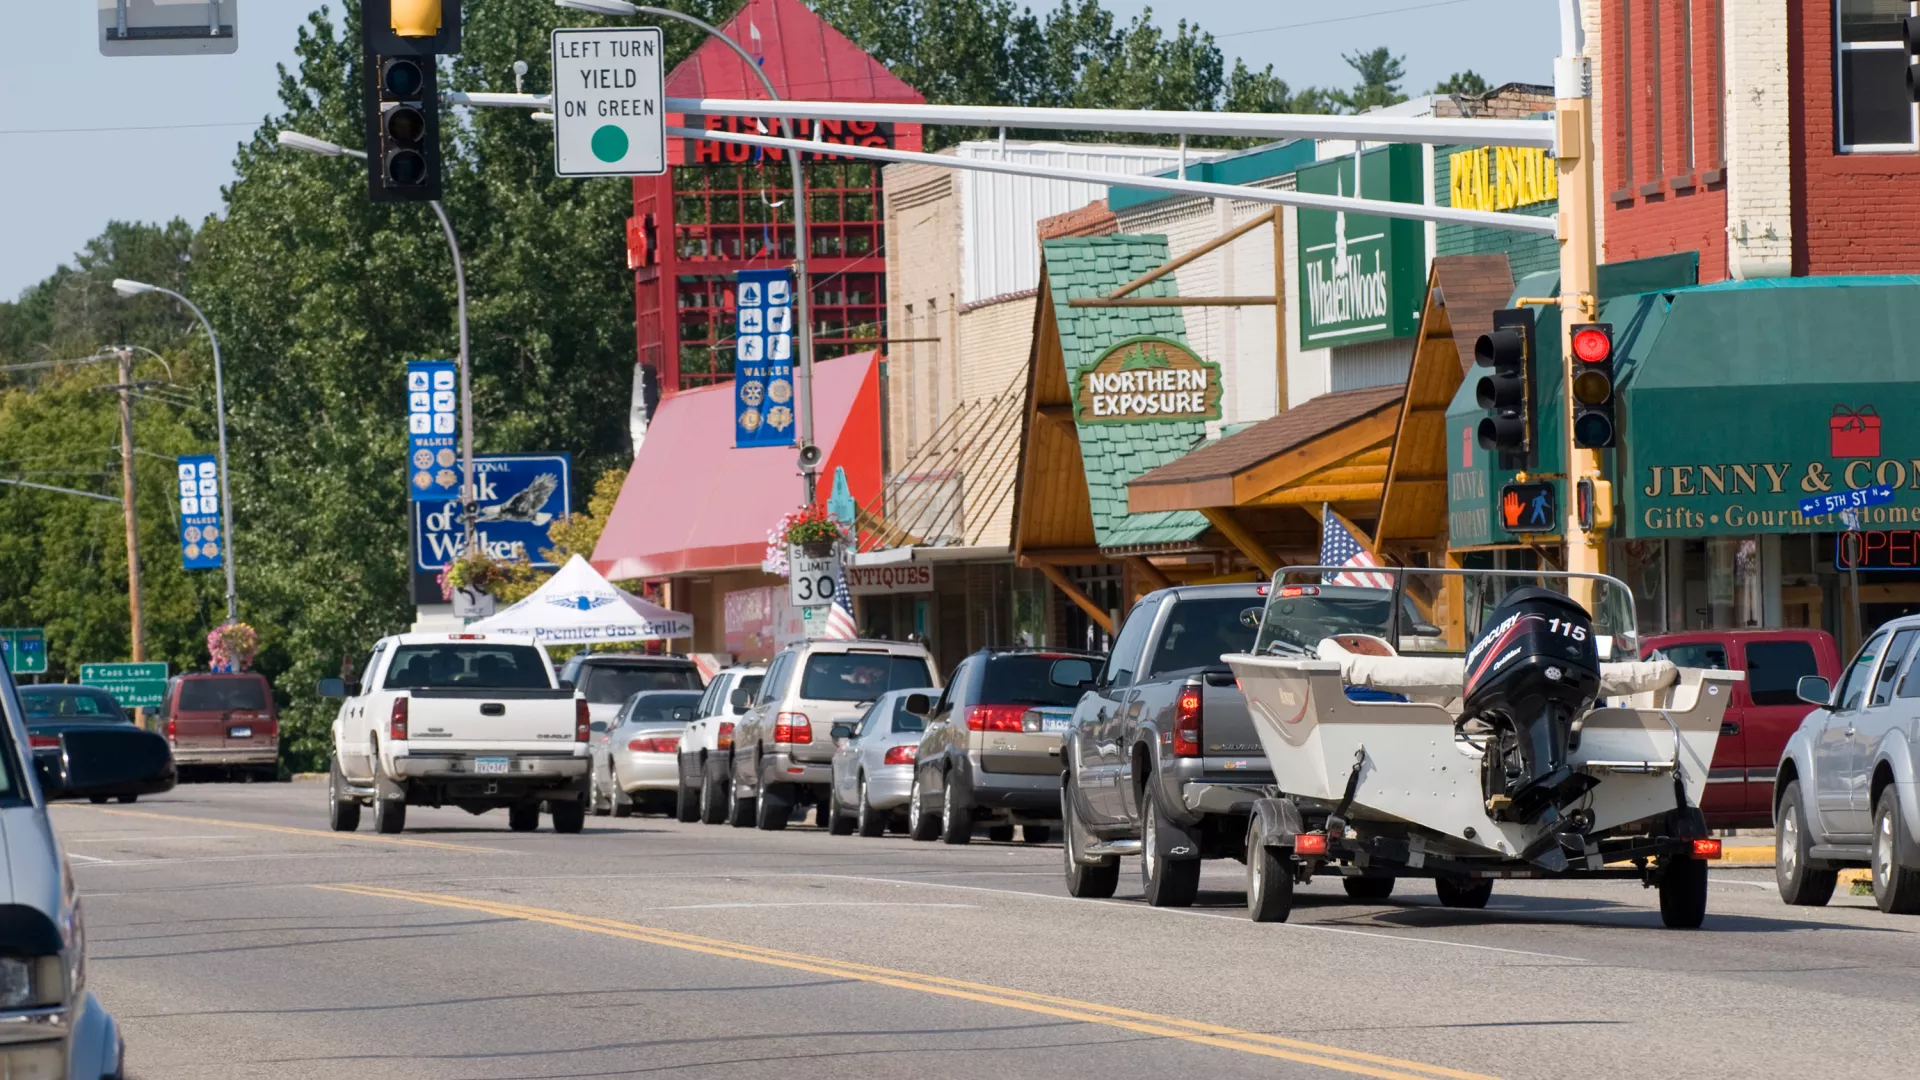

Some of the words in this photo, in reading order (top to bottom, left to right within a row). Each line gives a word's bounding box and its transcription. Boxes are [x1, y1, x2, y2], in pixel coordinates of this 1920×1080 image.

[561, 41, 601, 58] LEFT
[610, 40, 654, 57] TURN
[580, 68, 637, 89] YIELD
[564, 100, 587, 117] ON
[598, 99, 654, 116] GREEN
[1449, 146, 1494, 212] REAL
[1496, 146, 1558, 210] ESTATE
[743, 366, 790, 377] WALKER
[1089, 369, 1207, 393] NORTHERN
[1093, 391, 1205, 415] EXPOSURE
[415, 437, 453, 447] WALKER
[456, 462, 510, 473] NTIONAL
[1645, 463, 1790, 496] JENNY
[1800, 461, 1832, 492] &
[1815, 499, 1820, 507] S
[1825, 494, 1846, 511] 5TH
[1852, 490, 1867, 506] ST
[1872, 488, 1878, 496] N
[426, 502, 457, 532] of
[1644, 507, 1704, 529] Gifts
[799, 561, 831, 573] LIMIT
[848, 565, 930, 589] NTIQUES
[798, 575, 836, 601] 30
[535, 627, 600, 641] Premier
[605, 623, 637, 637] Gas
[642, 620, 677, 636] Grill
[1549, 618, 1587, 641] 115
[99, 668, 123, 677] Cass
[127, 668, 151, 677] Lake
